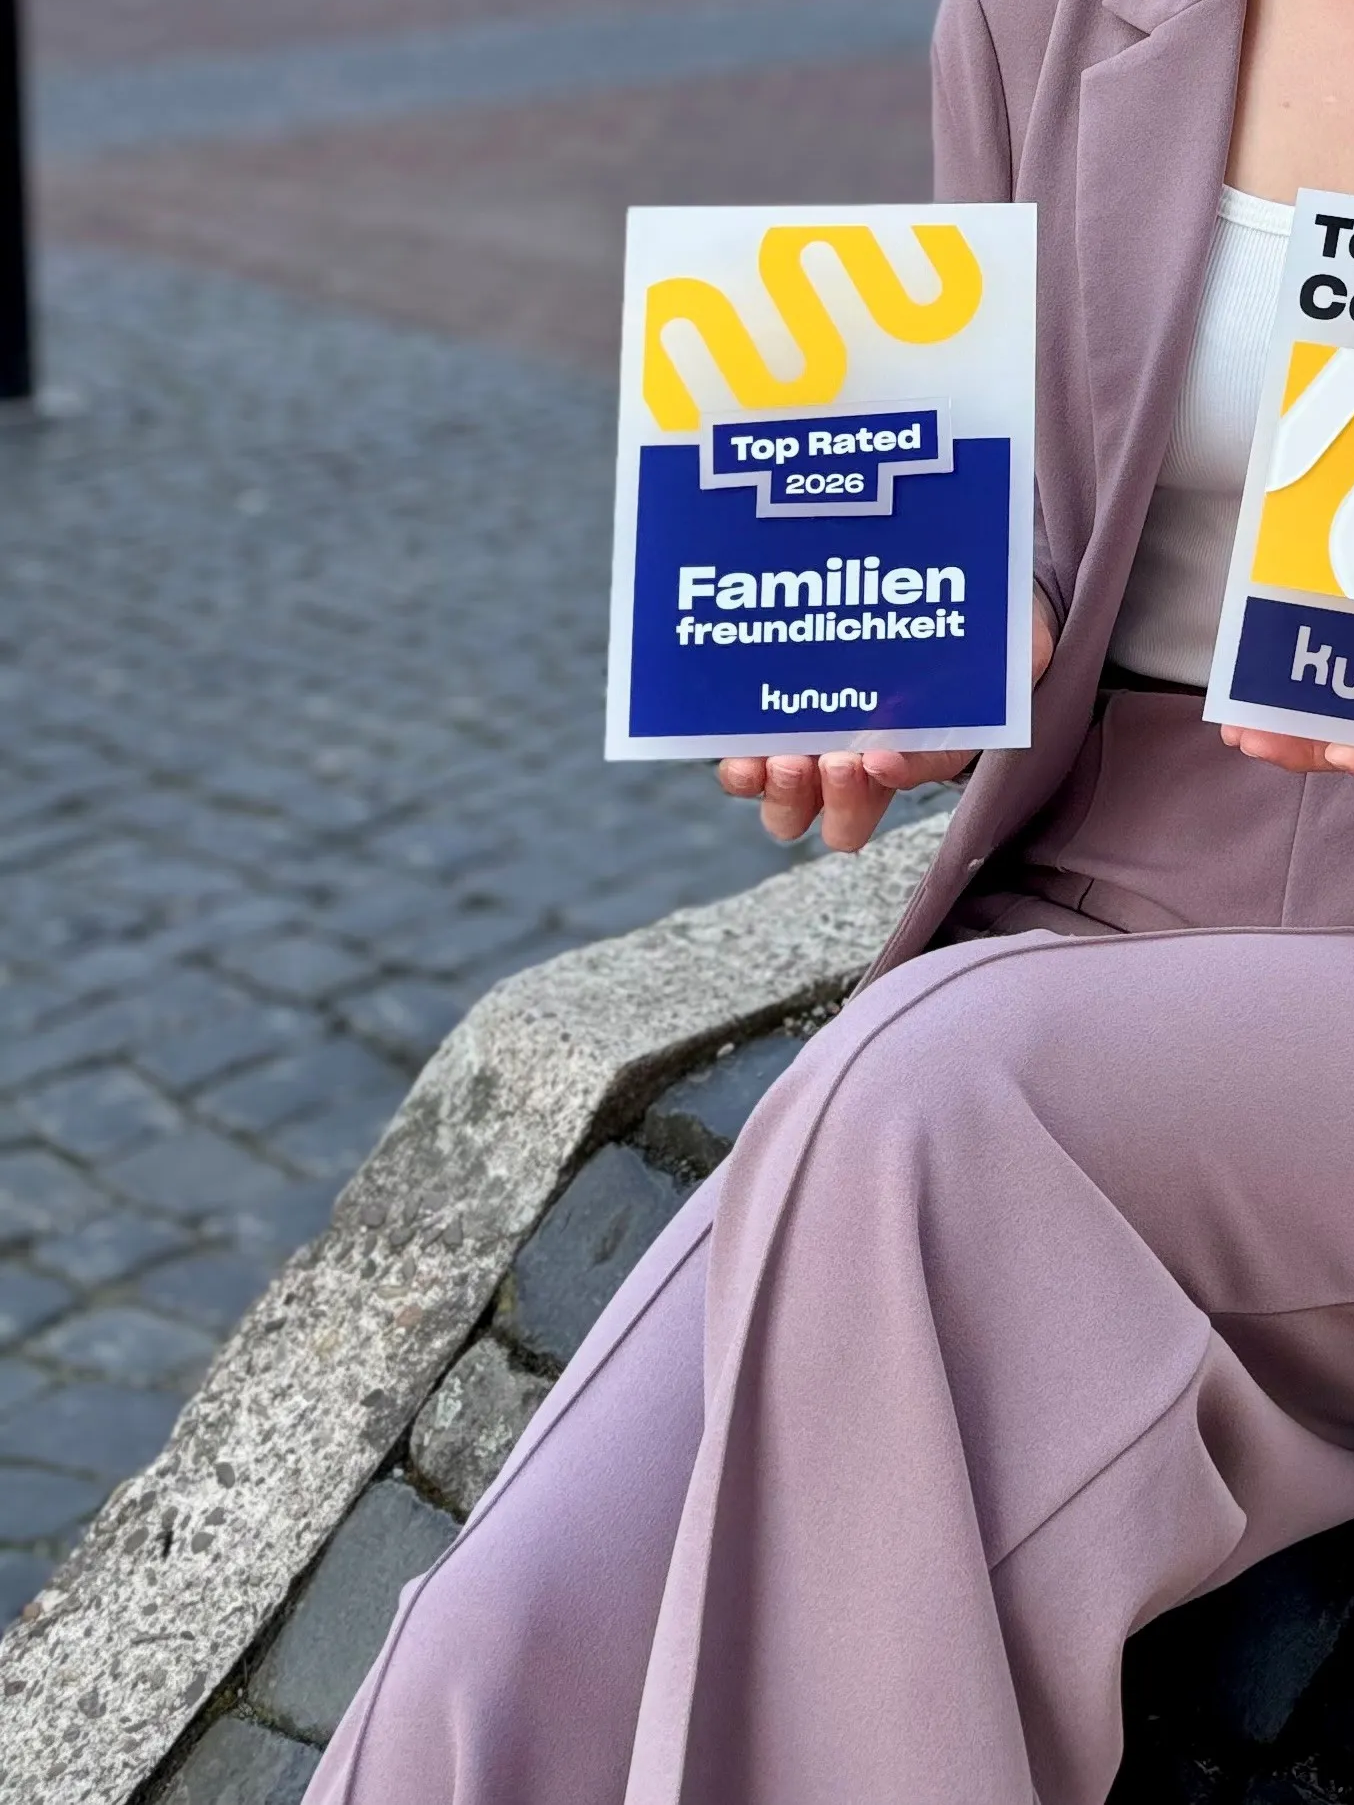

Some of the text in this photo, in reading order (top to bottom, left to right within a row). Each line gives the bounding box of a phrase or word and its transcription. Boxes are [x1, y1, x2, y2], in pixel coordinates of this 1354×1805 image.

[730, 423, 922, 465] Top Rated
[784, 472, 865, 496] 2026
[677, 555, 966, 611] Familien
[675, 608, 966, 646] freundlichkeit
[760, 683, 879, 714] kununu
